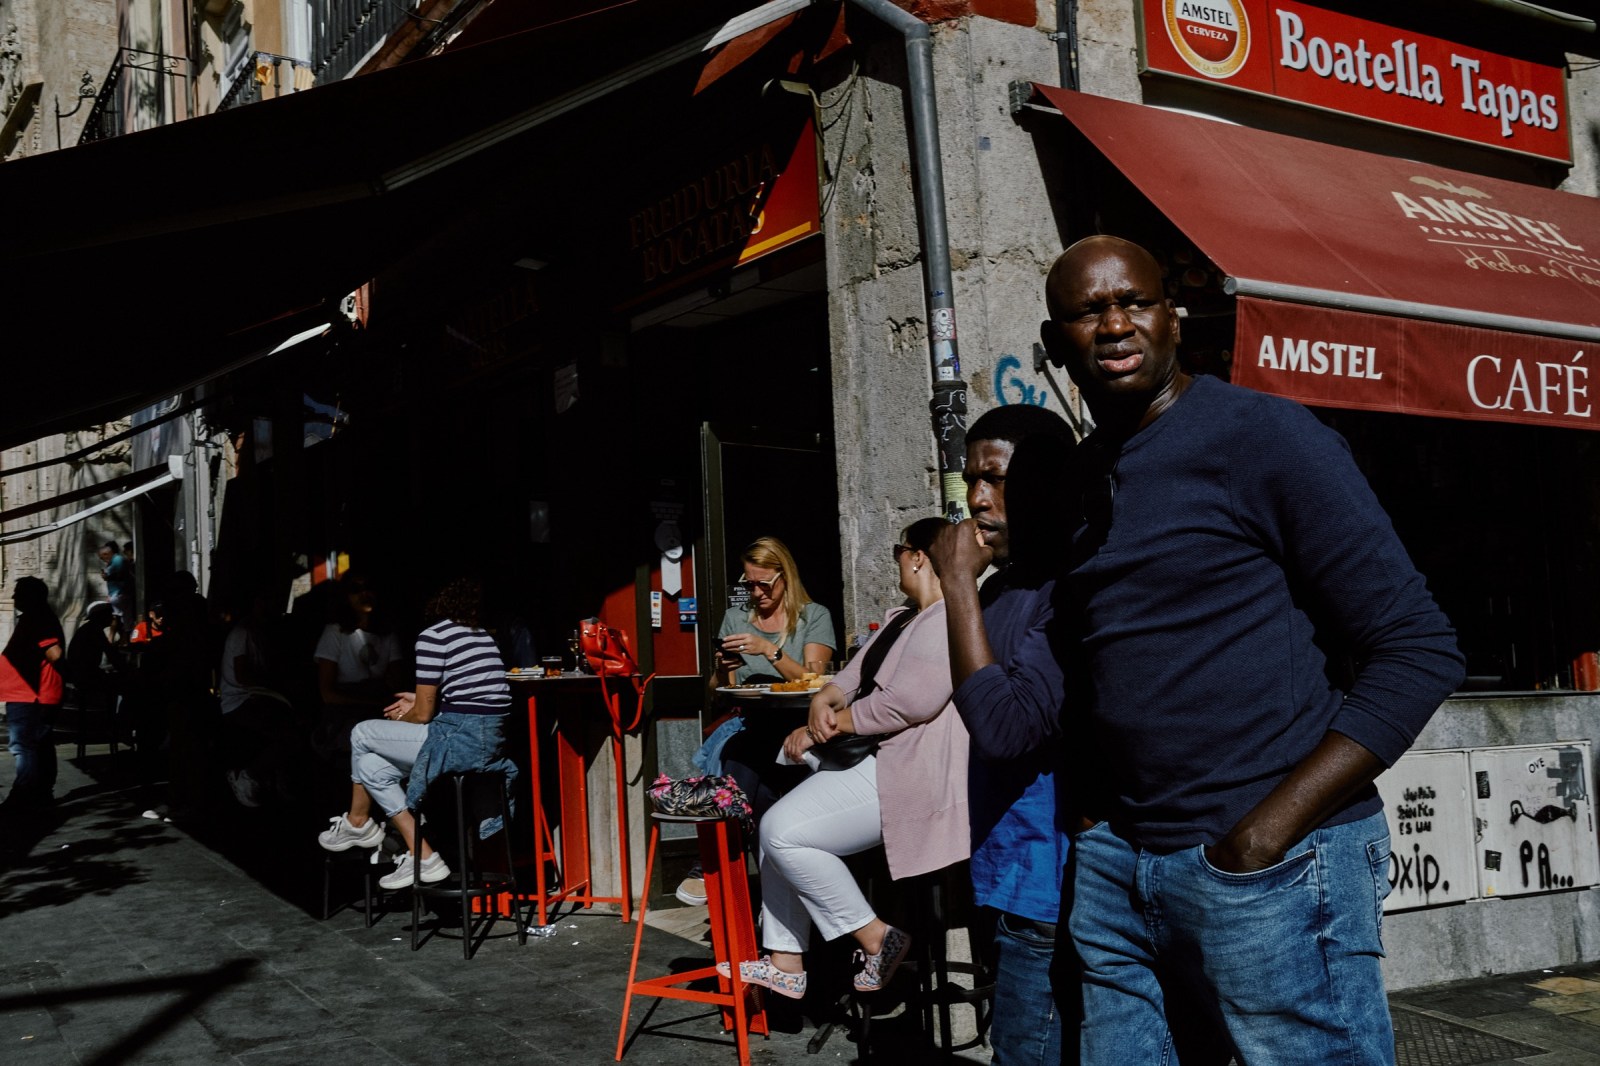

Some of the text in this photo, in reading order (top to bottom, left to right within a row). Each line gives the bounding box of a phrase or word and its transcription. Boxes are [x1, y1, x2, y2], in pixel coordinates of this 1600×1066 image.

[1181, 2, 1233, 26] AMSTEL
[1186, 25, 1229, 42] CERVEZA
[1276, 9, 1559, 137] Boatella Tapas
[1391, 191, 1585, 252] AMSTEL
[1419, 225, 1517, 243] PREMIUM
[1257, 335, 1382, 380] AMSTEL
[1466, 350, 1592, 417] CAFÉ
